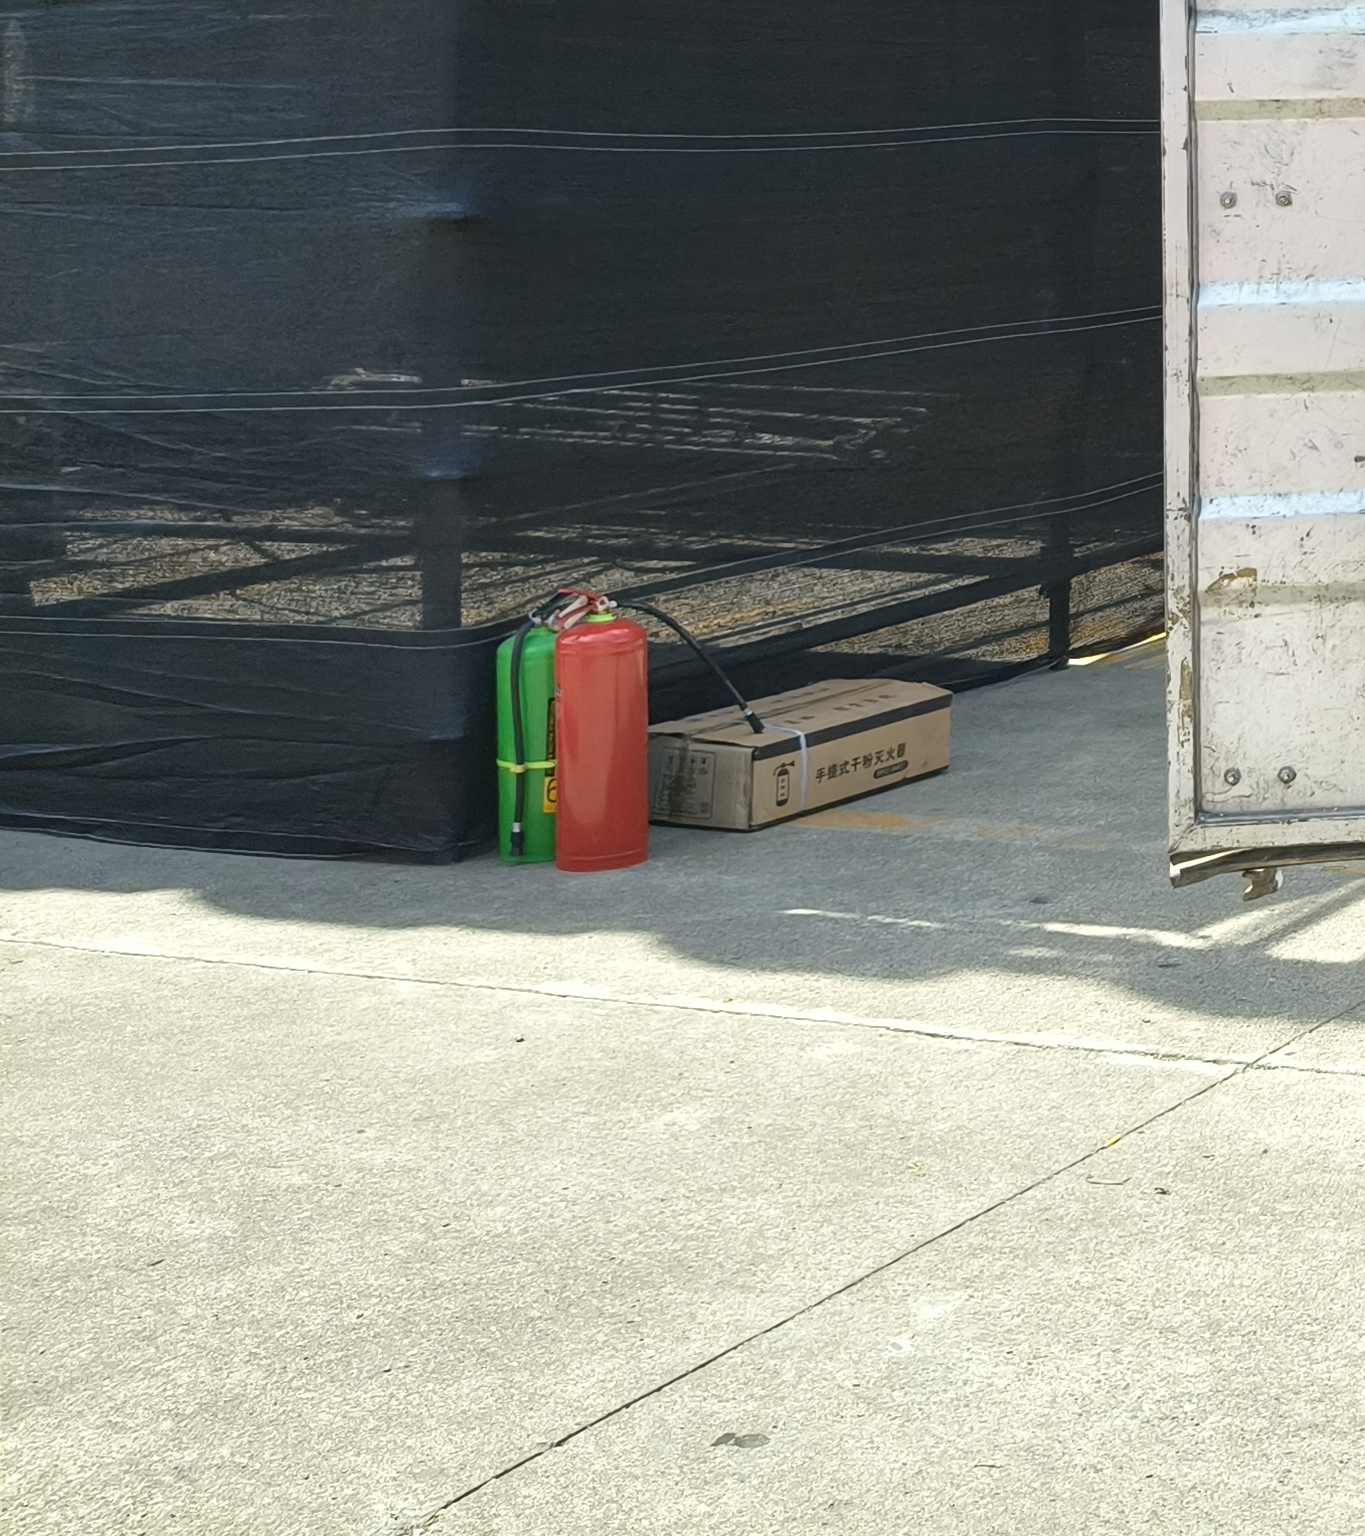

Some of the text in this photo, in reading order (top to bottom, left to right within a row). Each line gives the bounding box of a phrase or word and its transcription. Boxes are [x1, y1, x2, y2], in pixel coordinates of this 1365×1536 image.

[815, 742, 906, 784] 手提式干粉灭火器
